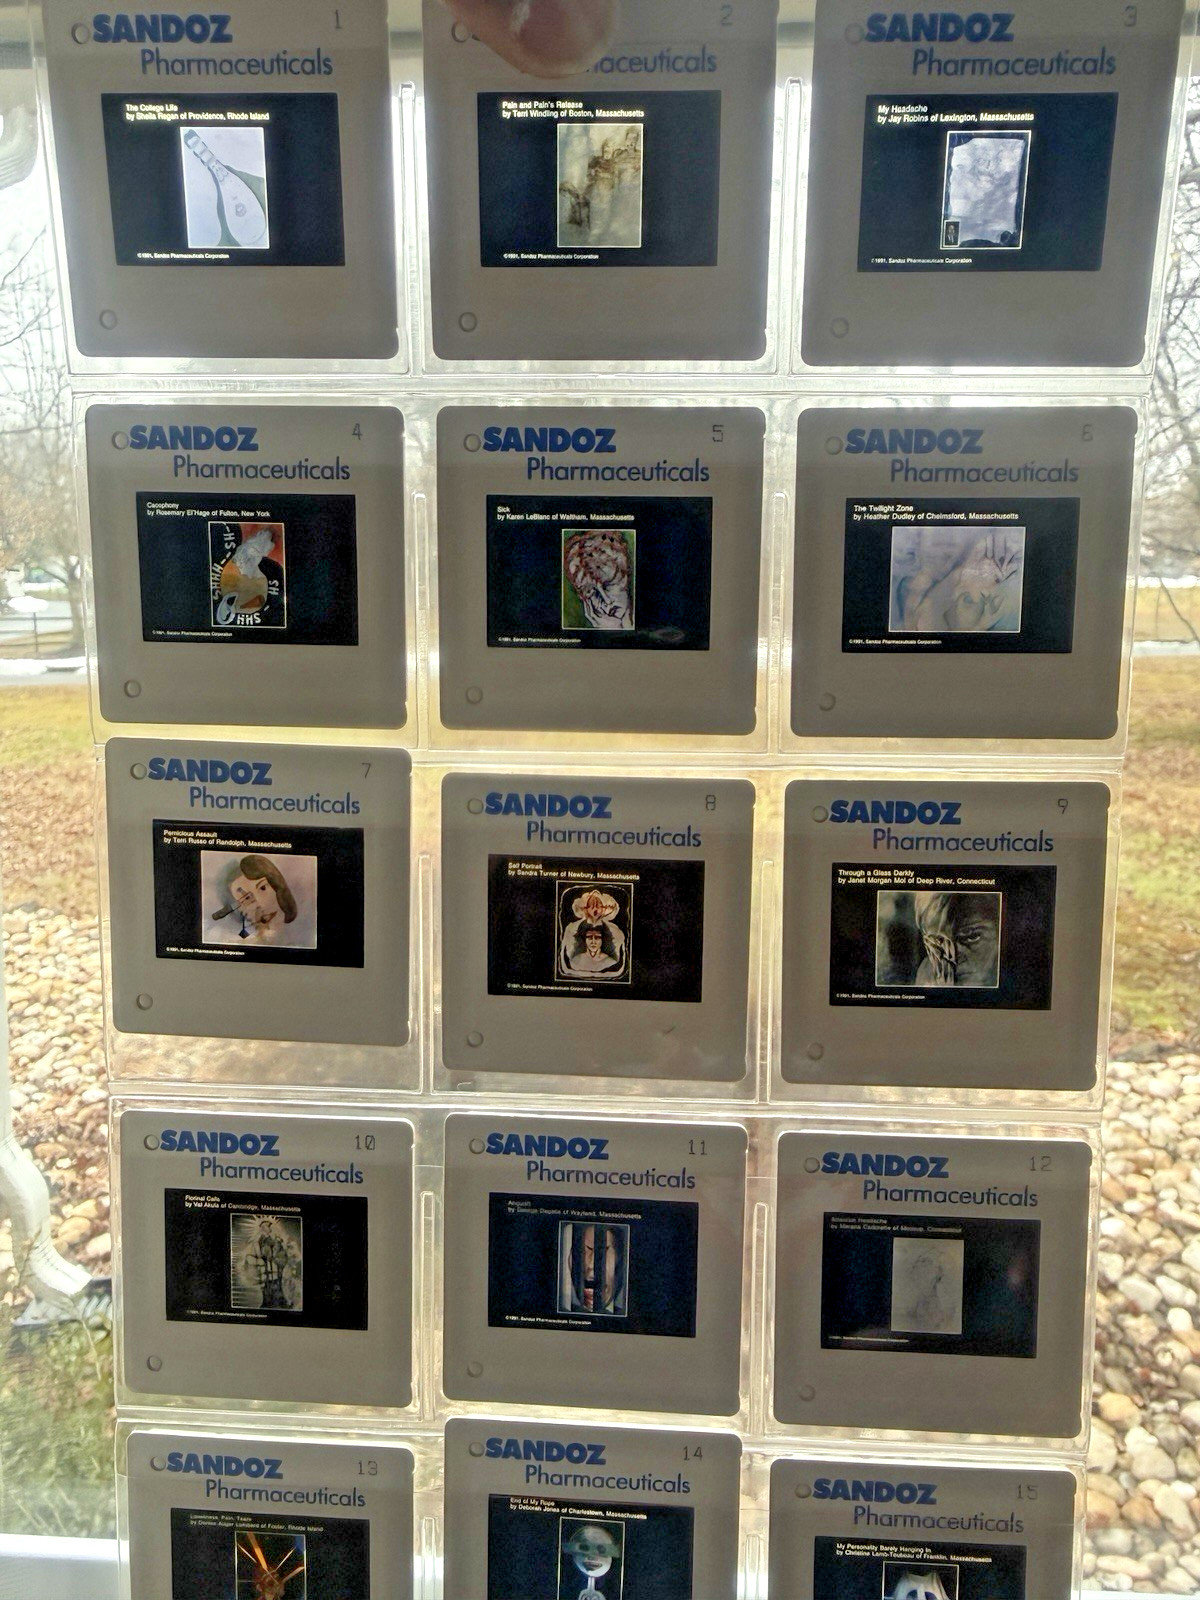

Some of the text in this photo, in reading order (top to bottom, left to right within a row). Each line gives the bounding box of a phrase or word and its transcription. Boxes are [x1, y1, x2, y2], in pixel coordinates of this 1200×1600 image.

[334, 10, 342, 29] 1
[720, 4, 732, 26] 2
[864, 13, 1015, 42] SANDOZ
[1124, 5, 1137, 27] 3
[93, 14, 232, 43] SANDOZ
[140, 46, 333, 75] Pharmaceuticals
[594, 44, 718, 73] aceuticals
[912, 46, 1115, 76] Pharmaceuticals
[130, 425, 258, 451] SANDOZ
[352, 423, 362, 440] 4
[483, 426, 616, 453] SANDOZ
[712, 424, 724, 442] 5
[845, 428, 984, 454] SANDOZ
[1082, 424, 1093, 442] 6
[174, 454, 350, 480] Pharmaceuticals
[528, 456, 710, 482] Pharmaceuticals
[891, 458, 1078, 482] Pharmaceuticals
[148, 758, 272, 785] SANDOZ
[361, 763, 372, 779] 7
[190, 786, 360, 814] Pharmaceuticals
[485, 792, 612, 819] SANDOZ
[705, 794, 716, 811] 8
[829, 800, 961, 825] SANDOZ
[1058, 798, 1069, 814] 9
[527, 820, 701, 847] Pharmaceuticals
[873, 827, 1054, 852] Pharmaceuticals
[160, 1129, 280, 1156] SANDOZ
[486, 1133, 609, 1160] SANDOZ
[688, 1139, 707, 1155] 11
[200, 1156, 363, 1184] Pharmaceuticals
[527, 1160, 696, 1188] Pharmaceuticals
[821, 1152, 949, 1178] SANDOZ
[1030, 1156, 1052, 1172] 12
[863, 1179, 1038, 1206] Pharmaceuticals
[485, 1437, 606, 1465] SANDOZ
[683, 1445, 702, 1461] 14
[167, 1452, 283, 1479] SANDOZ
[358, 1460, 378, 1476] 13
[525, 1464, 690, 1493] Pharmaceuticals
[206, 1479, 366, 1507] Pharmaceuticals
[812, 1478, 938, 1505] SANDOZ
[1016, 1484, 1038, 1500] 15
[854, 1505, 1024, 1533] Pharmaceuticals
